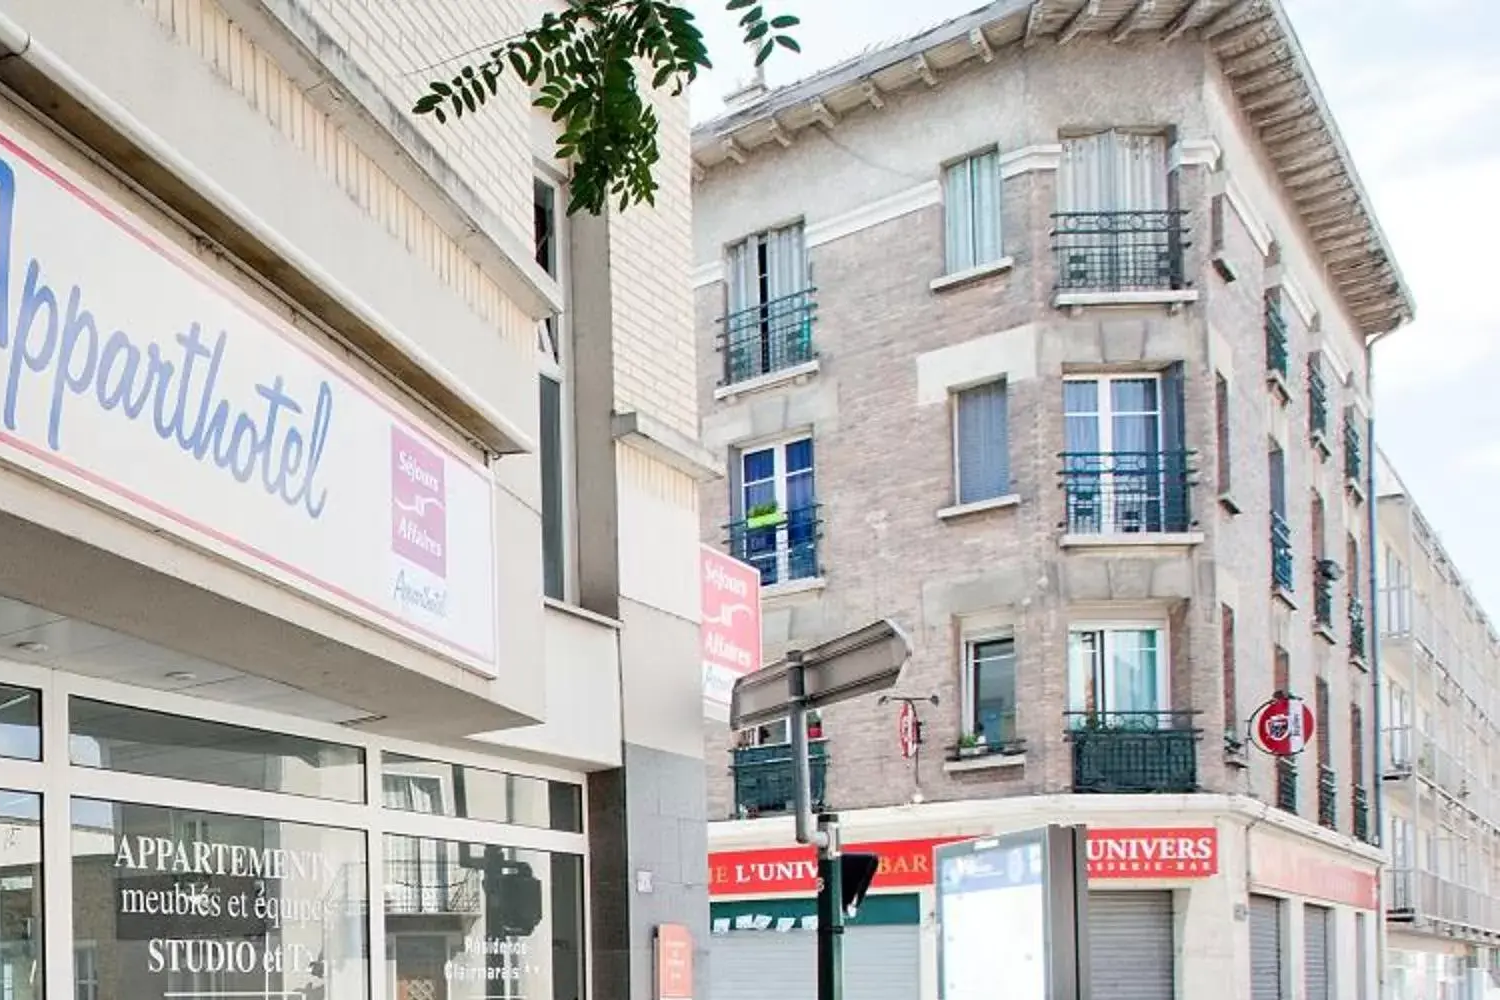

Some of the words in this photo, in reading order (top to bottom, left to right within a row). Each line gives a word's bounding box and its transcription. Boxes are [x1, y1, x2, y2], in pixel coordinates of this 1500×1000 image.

[397, 451, 439, 492] Séjours
[735, 860, 819, 884] L'UNIV
[121, 882, 222, 918] meublés
[227, 892, 248, 918] et
[148, 939, 256, 974] STUDIO
[263, 946, 282, 973] et
